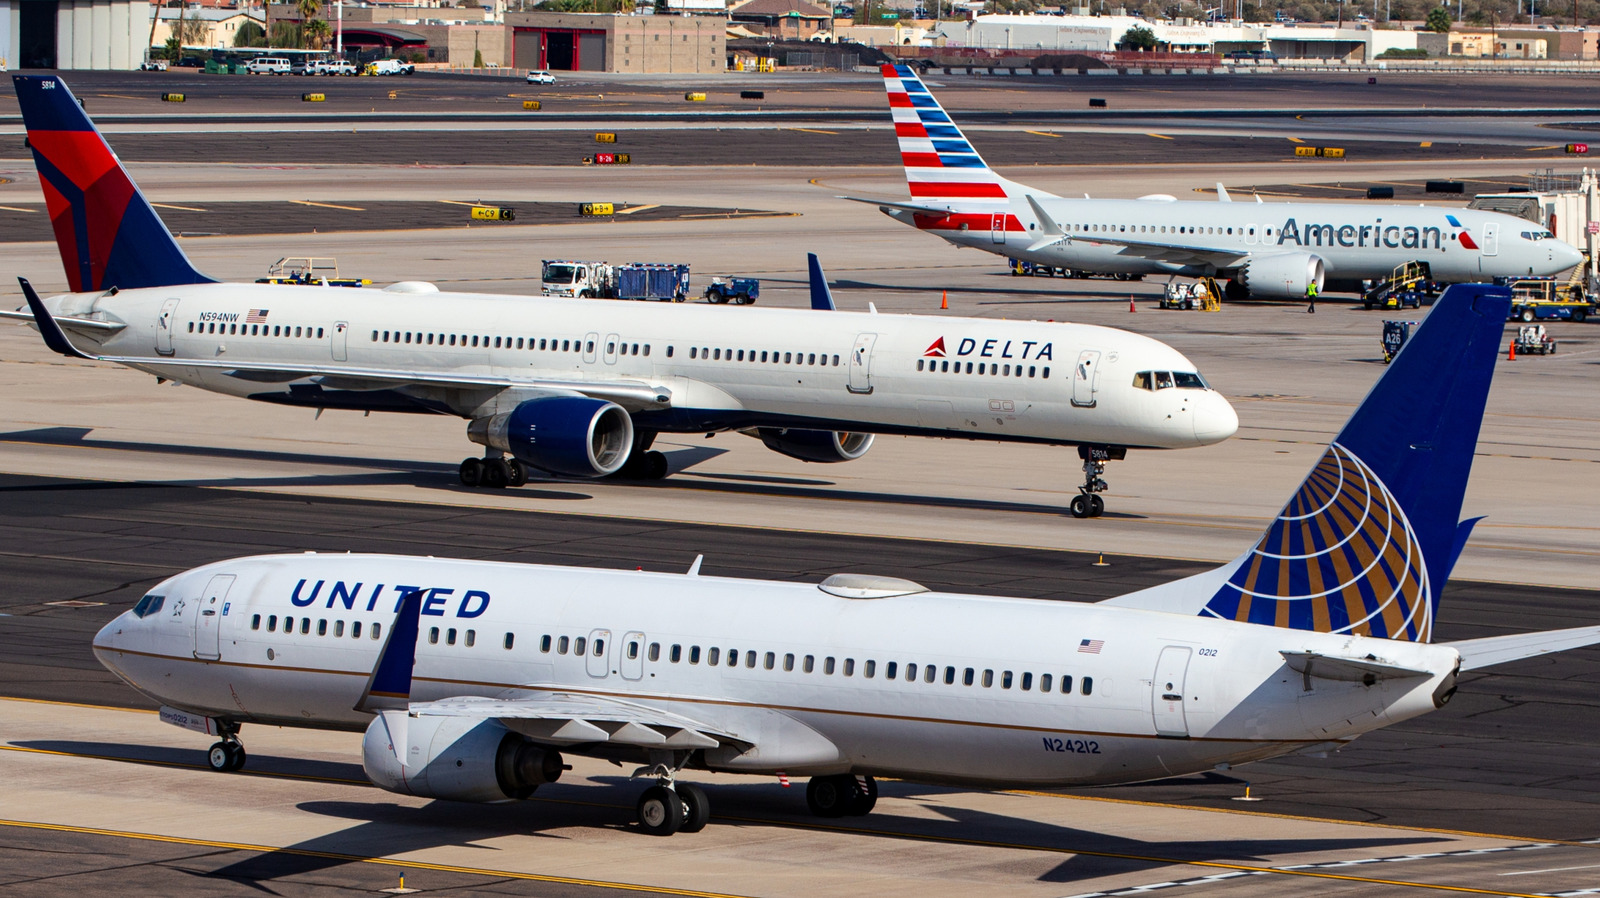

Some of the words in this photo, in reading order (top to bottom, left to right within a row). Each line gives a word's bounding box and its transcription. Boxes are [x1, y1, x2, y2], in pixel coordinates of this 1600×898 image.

[42, 81, 55, 89] 5814
[485, 209, 495, 218] C9
[502, 209, 508, 218] C
[599, 204, 604, 213] B
[1277, 217, 1441, 249] American
[199, 312, 240, 322] N594NW
[1386, 333, 1401, 345] A26
[957, 337, 1053, 361] DELTA
[1092, 449, 1108, 459] 5814
[290, 578, 491, 619] UNITED
[1198, 648, 1218, 657] 0212
[1042, 737, 1101, 754] N24212
